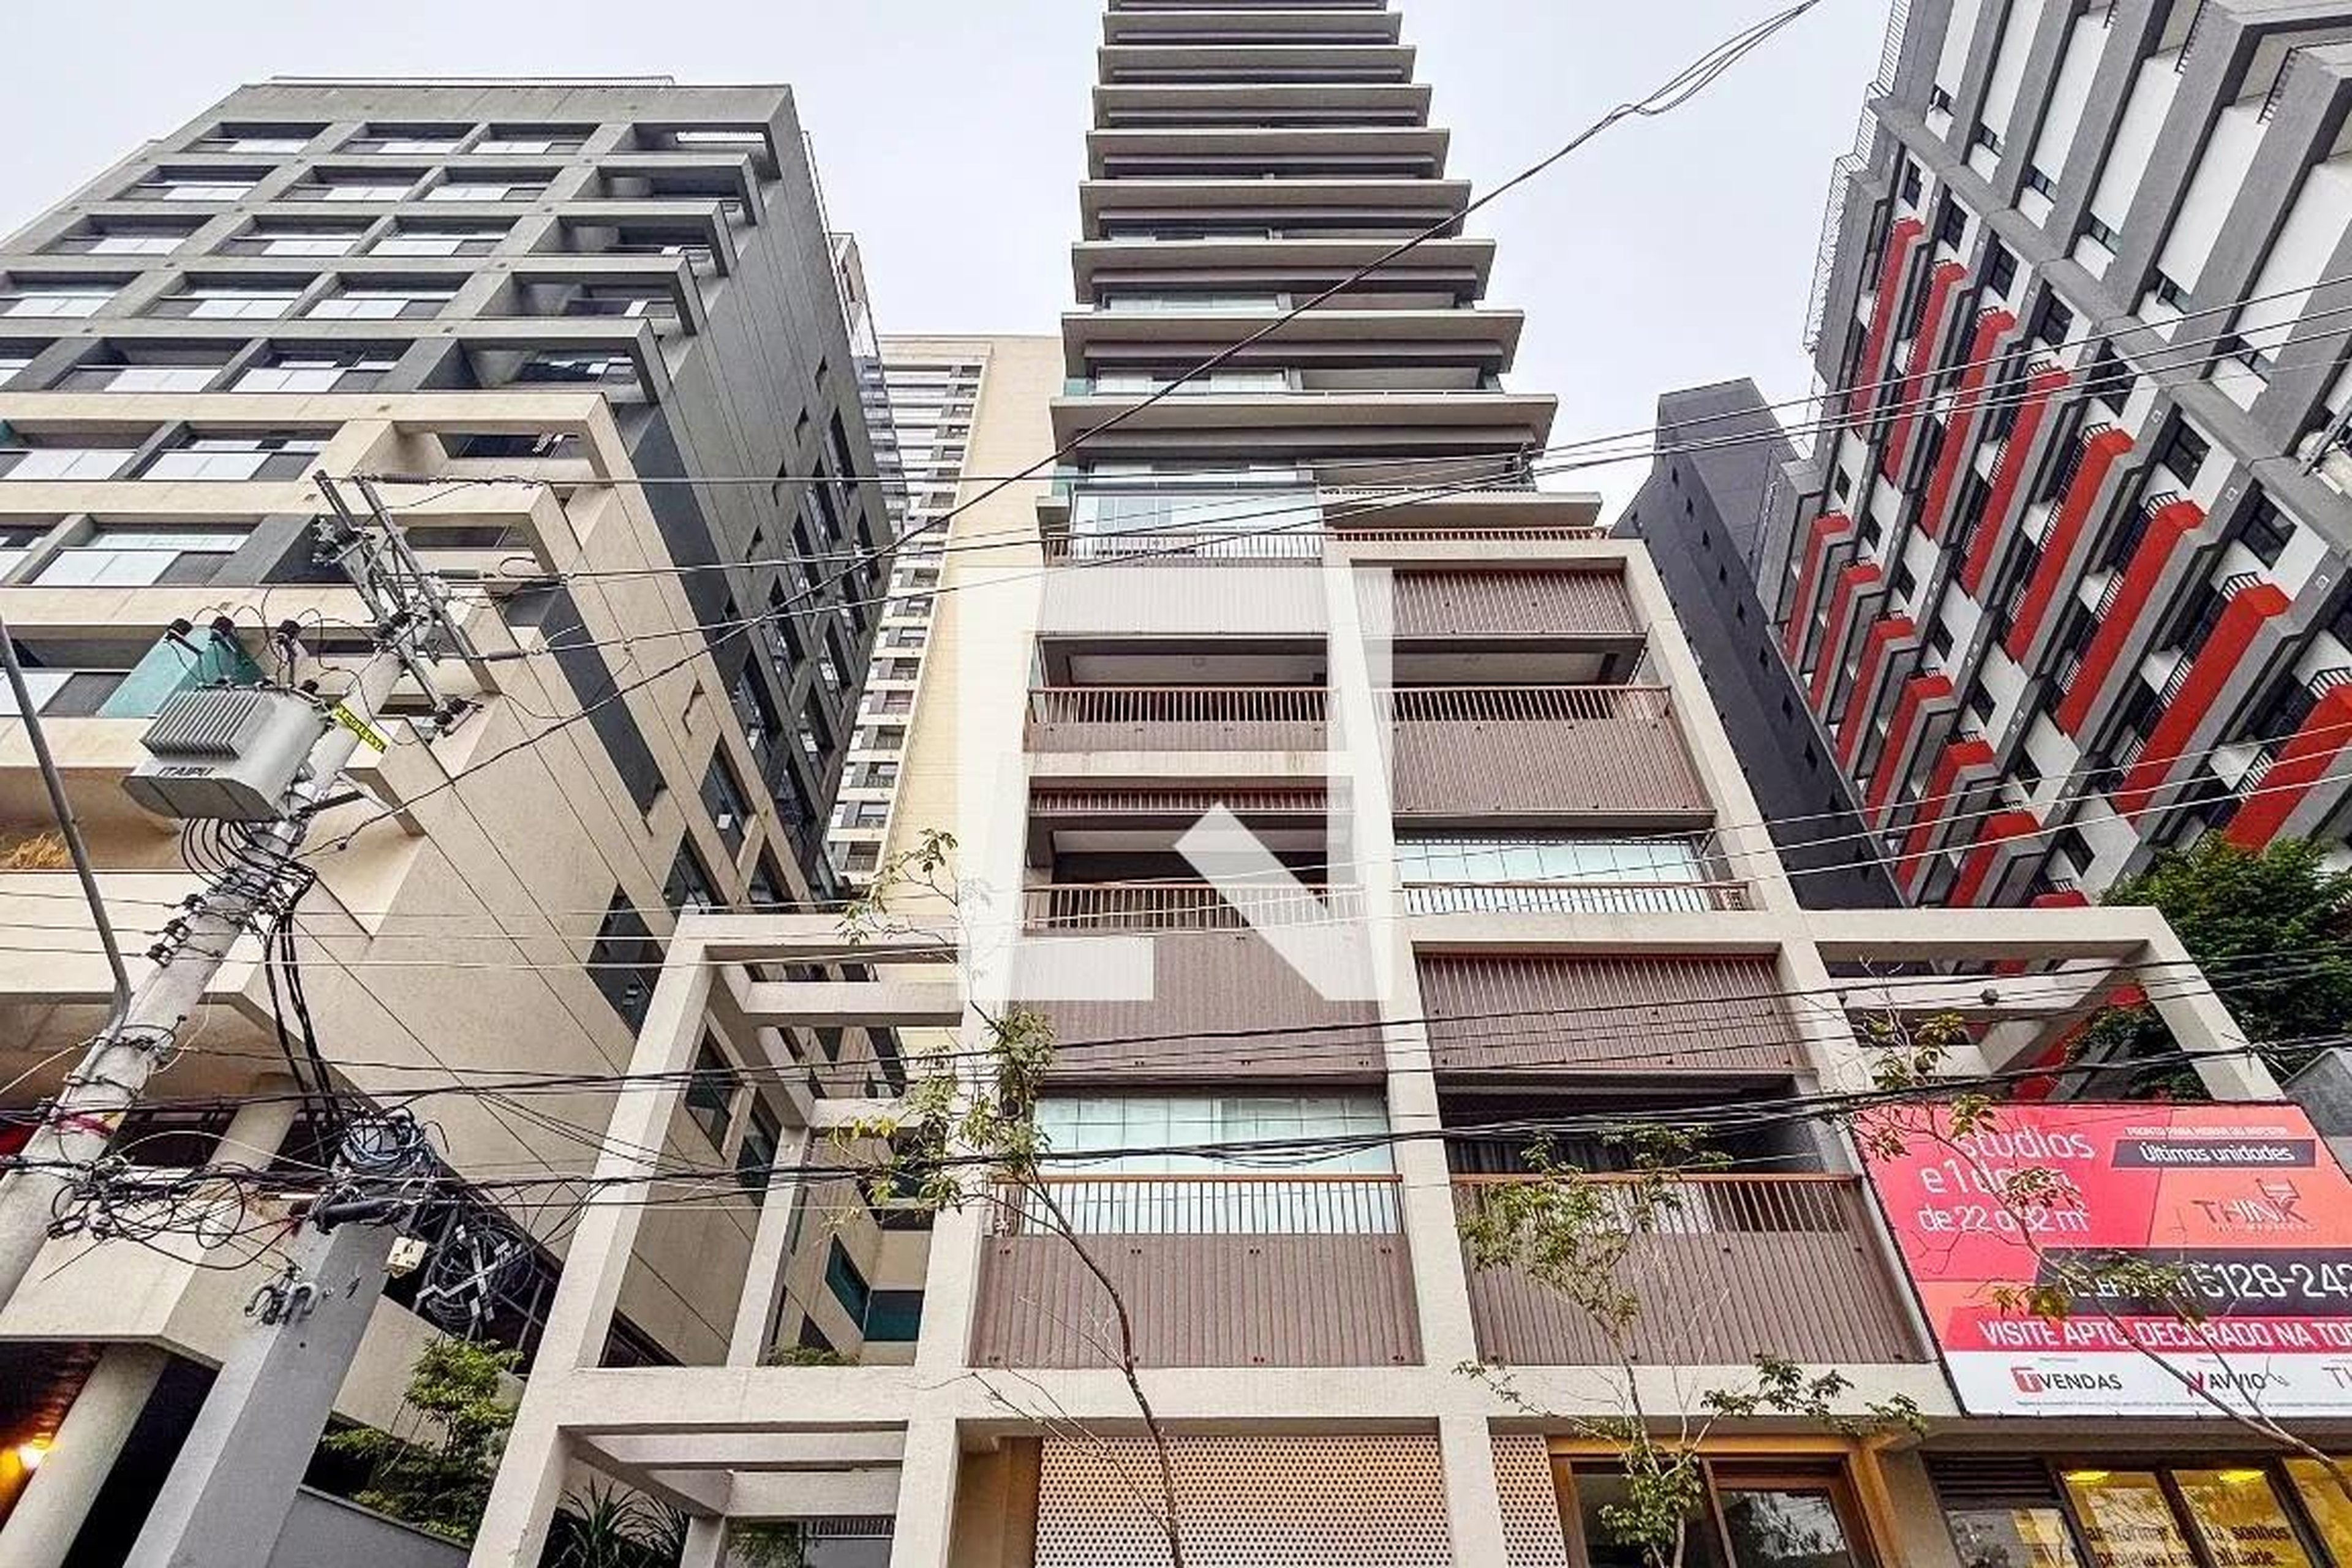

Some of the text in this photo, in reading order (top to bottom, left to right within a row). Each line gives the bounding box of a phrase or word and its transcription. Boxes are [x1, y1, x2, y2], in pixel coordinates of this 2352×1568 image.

[2210, 1144, 2296, 1161] unidades
[1918, 1204, 1954, 1231] de
[1954, 1205, 1994, 1231] 22
[1978, 1321, 2060, 1346] VISITE
[2133, 1321, 2274, 1347] DECORADO
[2271, 1322, 2318, 1347] NA
